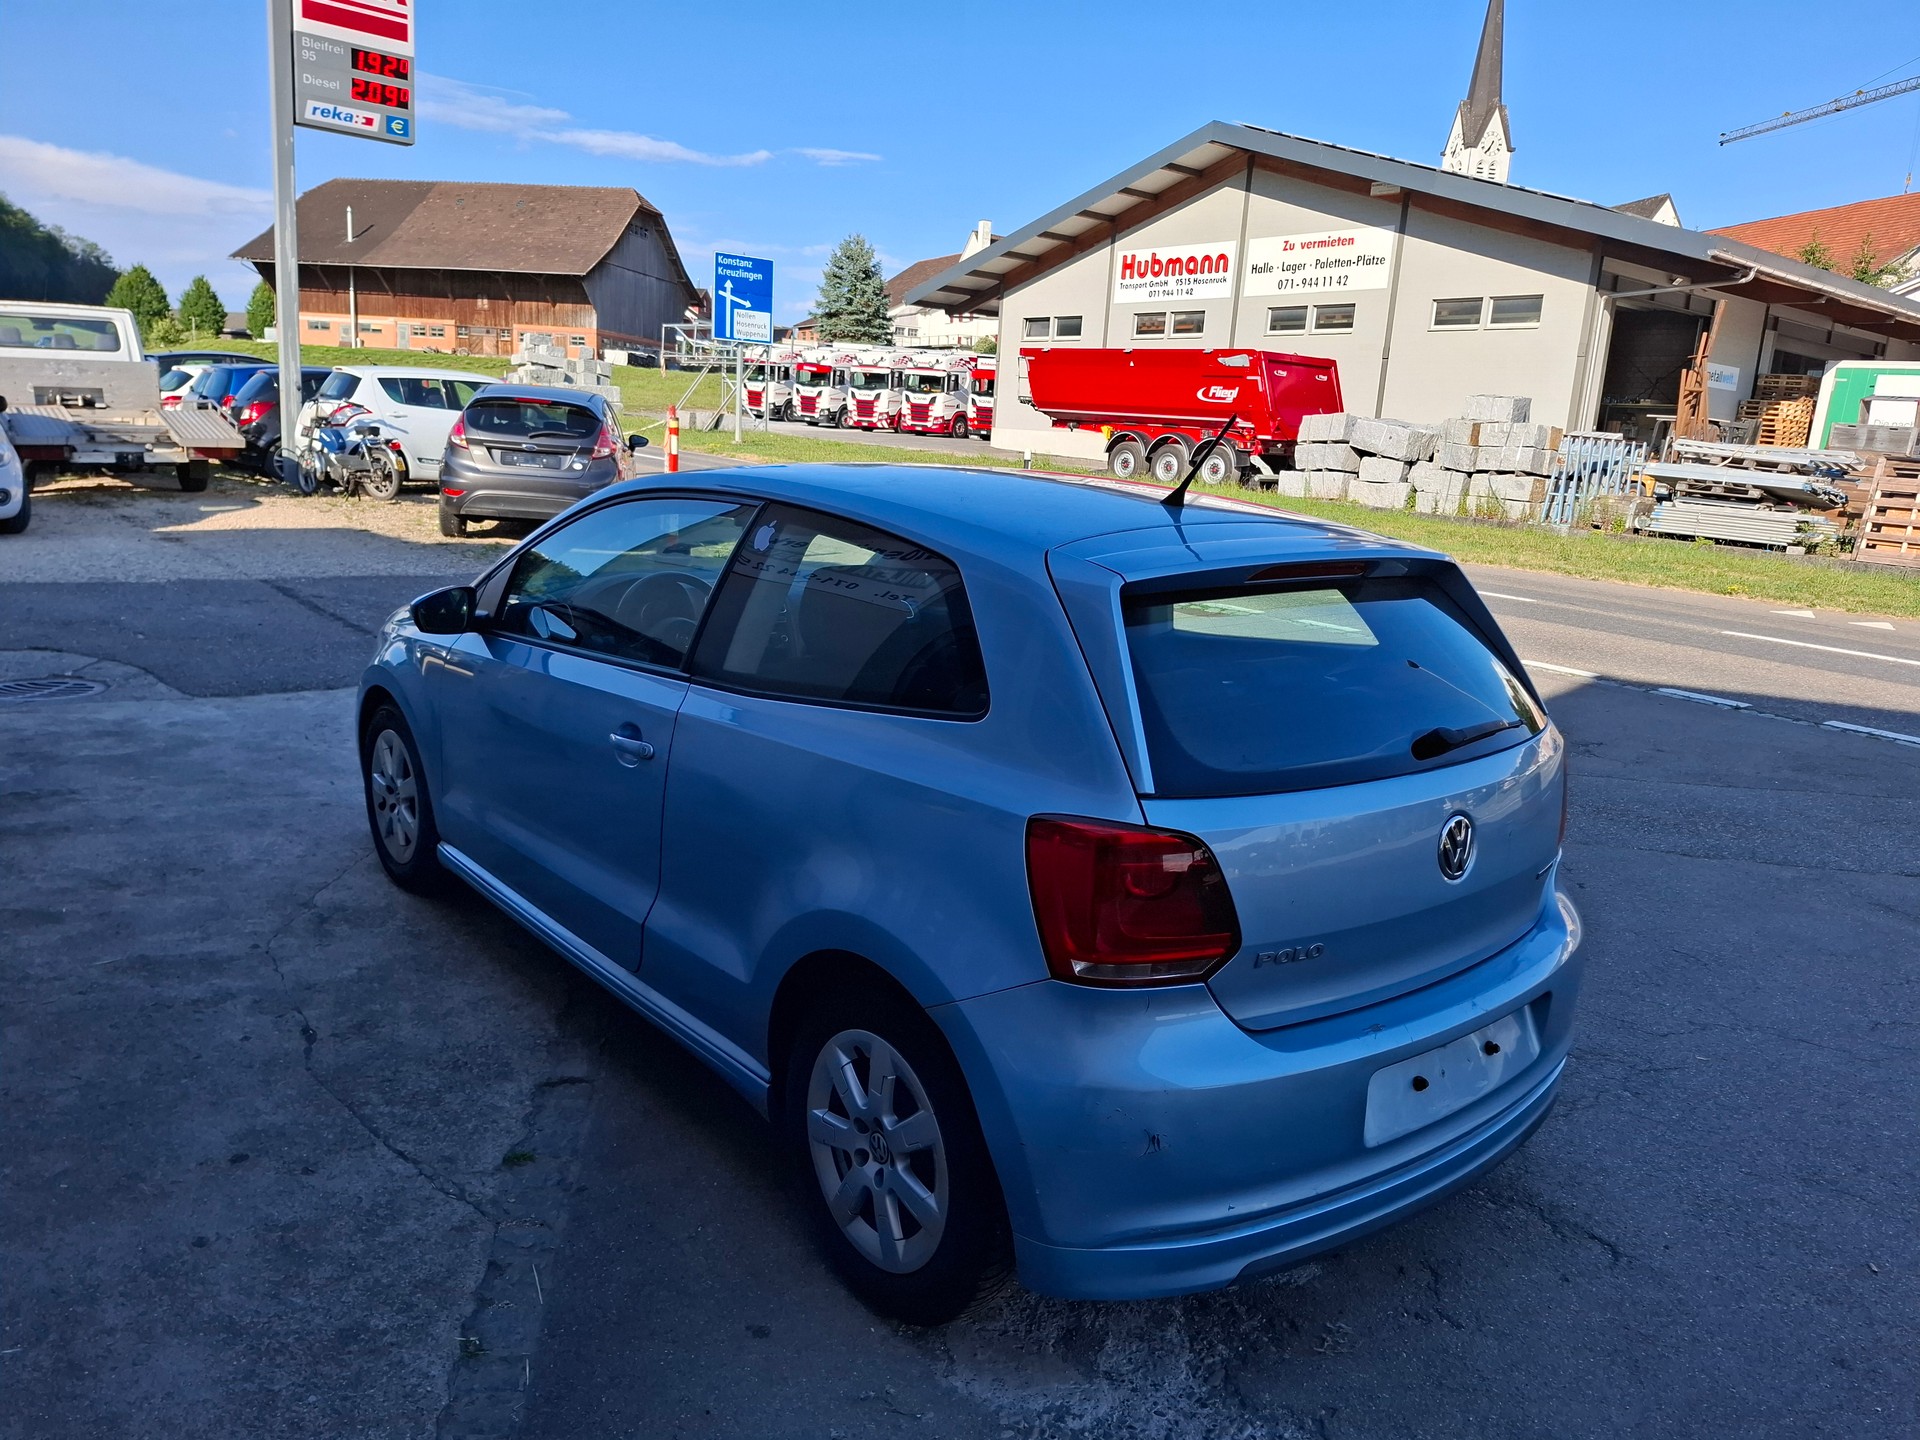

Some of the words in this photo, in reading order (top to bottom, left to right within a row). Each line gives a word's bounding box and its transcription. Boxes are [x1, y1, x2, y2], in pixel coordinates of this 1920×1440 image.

[302, 36, 344, 55] Bleifrei
[302, 49, 317, 61] 95
[303, 73, 340, 90] Diesel
[1283, 240, 1295, 251] Zu
[1300, 236, 1355, 250] vermieten
[718, 255, 753, 268] Konstanz
[1121, 252, 1229, 280] Hubmann
[1251, 262, 1274, 274] Halle
[1281, 262, 1307, 274] Lager
[1314, 254, 1386, 270] Paletten-Plätze
[718, 266, 763, 281] Kreuzlingen
[1322, 275, 1333, 287] 11
[1336, 275, 1349, 287] 42
[1120, 282, 1148, 291] Transport
[1149, 280, 1169, 288] GmbH
[1175, 278, 1191, 286] 9515
[1193, 276, 1227, 285] Hosenruck
[1185, 288, 1194, 296] 42
[736, 311, 756, 320] Nollen
[736, 320, 767, 330] Hosenruck
[736, 329, 768, 339] Wuppenau
[1209, 385, 1239, 402] Fliegl
[1254, 942, 1325, 969] POLO
